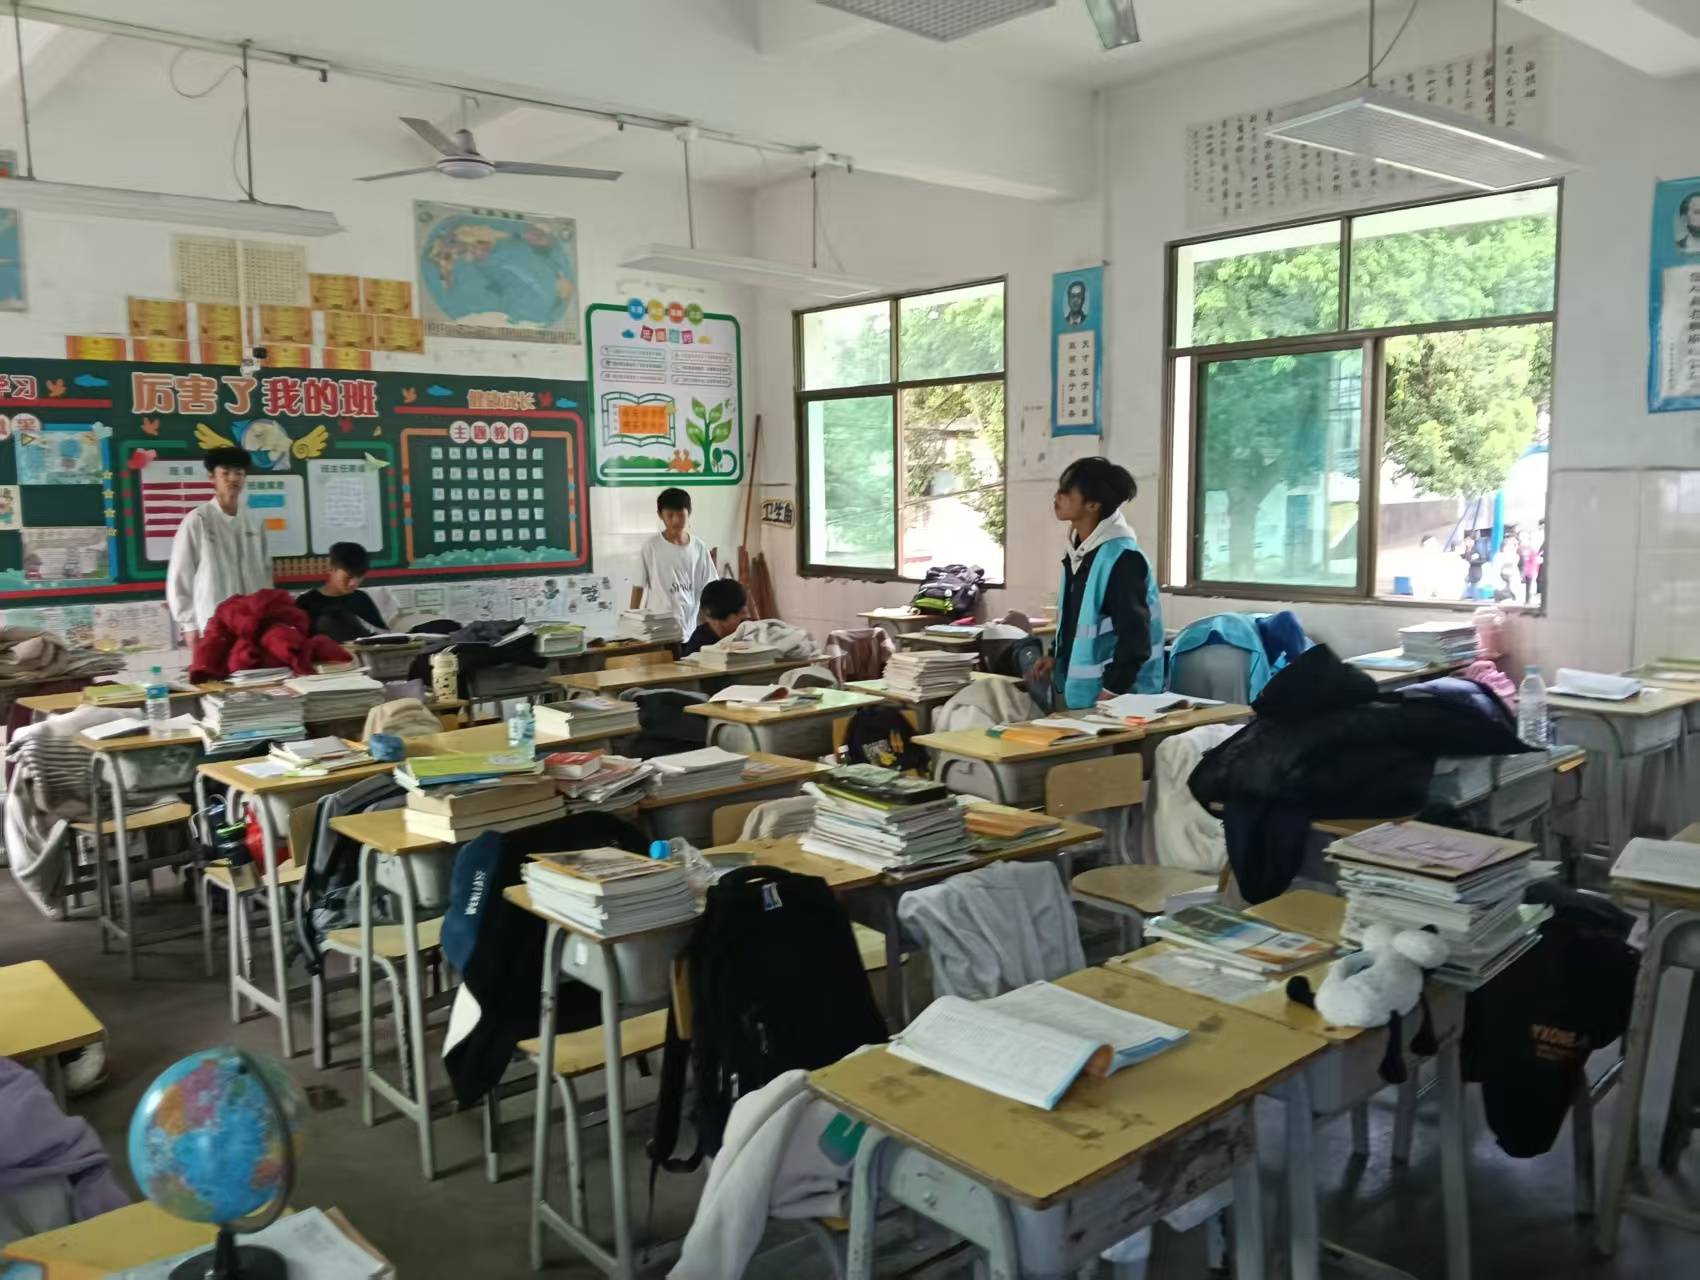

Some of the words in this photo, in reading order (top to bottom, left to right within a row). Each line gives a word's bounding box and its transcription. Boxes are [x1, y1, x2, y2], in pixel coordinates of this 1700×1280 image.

[132, 372, 378, 417] 厉害了我的班
[452, 423, 526, 442] 主题教育
